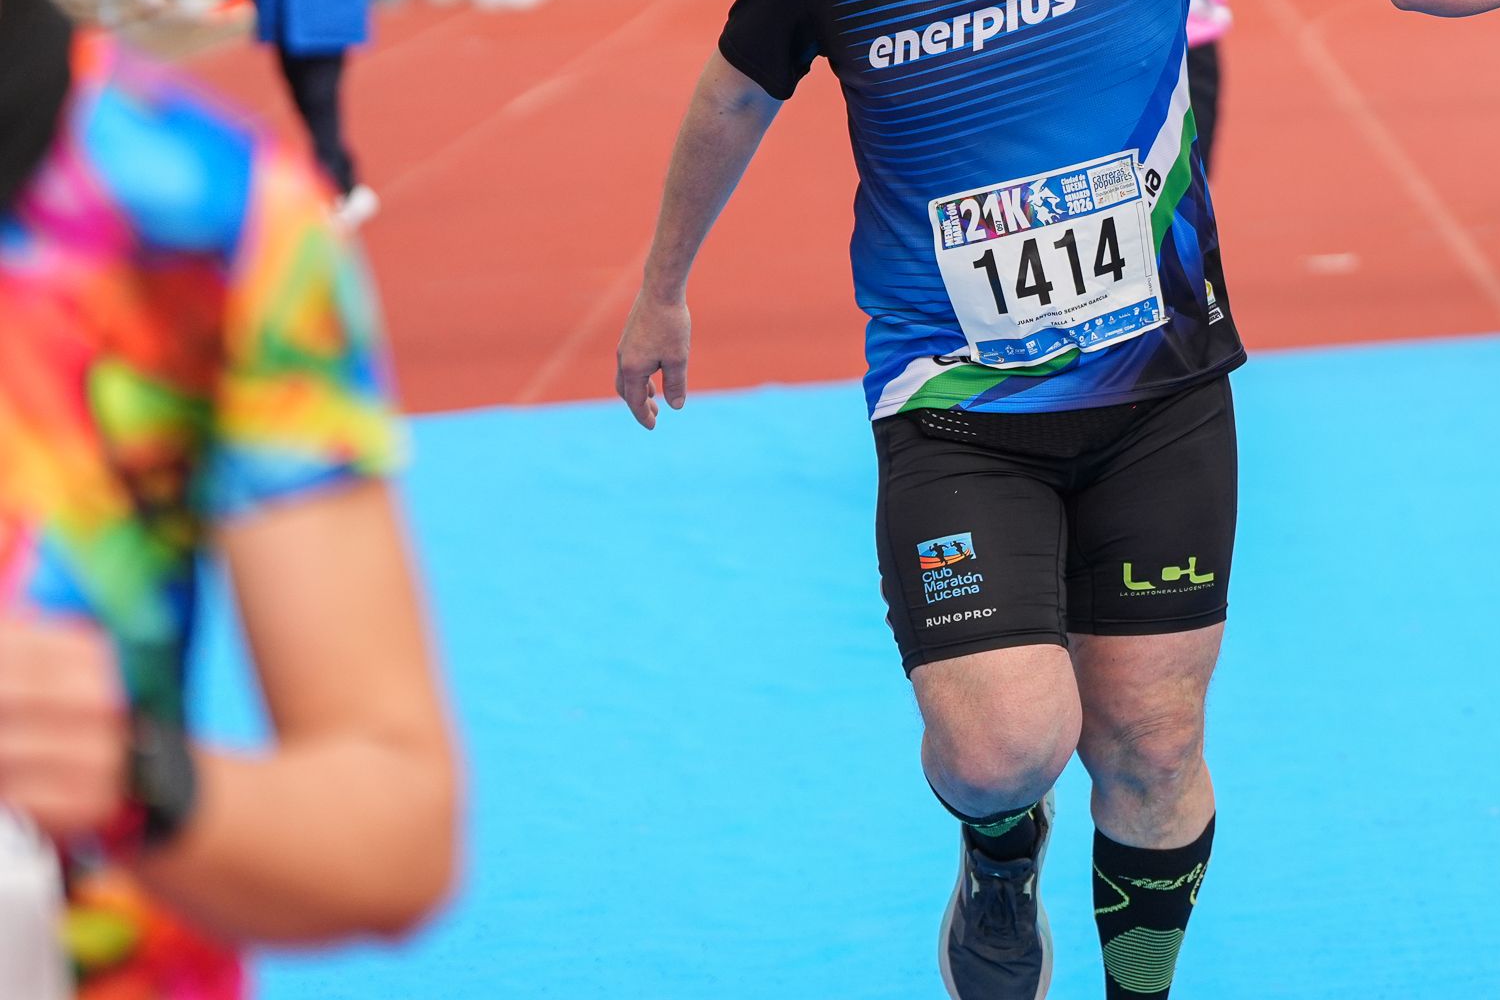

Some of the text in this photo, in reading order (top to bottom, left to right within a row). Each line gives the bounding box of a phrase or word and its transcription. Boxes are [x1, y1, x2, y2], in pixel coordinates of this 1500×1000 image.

[1092, 167, 1125, 185] carreras
[1093, 171, 1133, 193] populares
[1062, 180, 1088, 194] LUCENA
[960, 187, 1031, 243] 21K
[1066, 198, 1094, 216] 2026
[972, 216, 1126, 315] 1414
[1017, 318, 1034, 326] JUAN
[1035, 310, 1063, 321] ANTONIO
[922, 567, 953, 583] Club
[924, 571, 984, 594] Maratón
[925, 584, 980, 605] Lucena
[1130, 588, 1177, 597] CARTONERA
[1178, 583, 1215, 593] LUCENTINA
